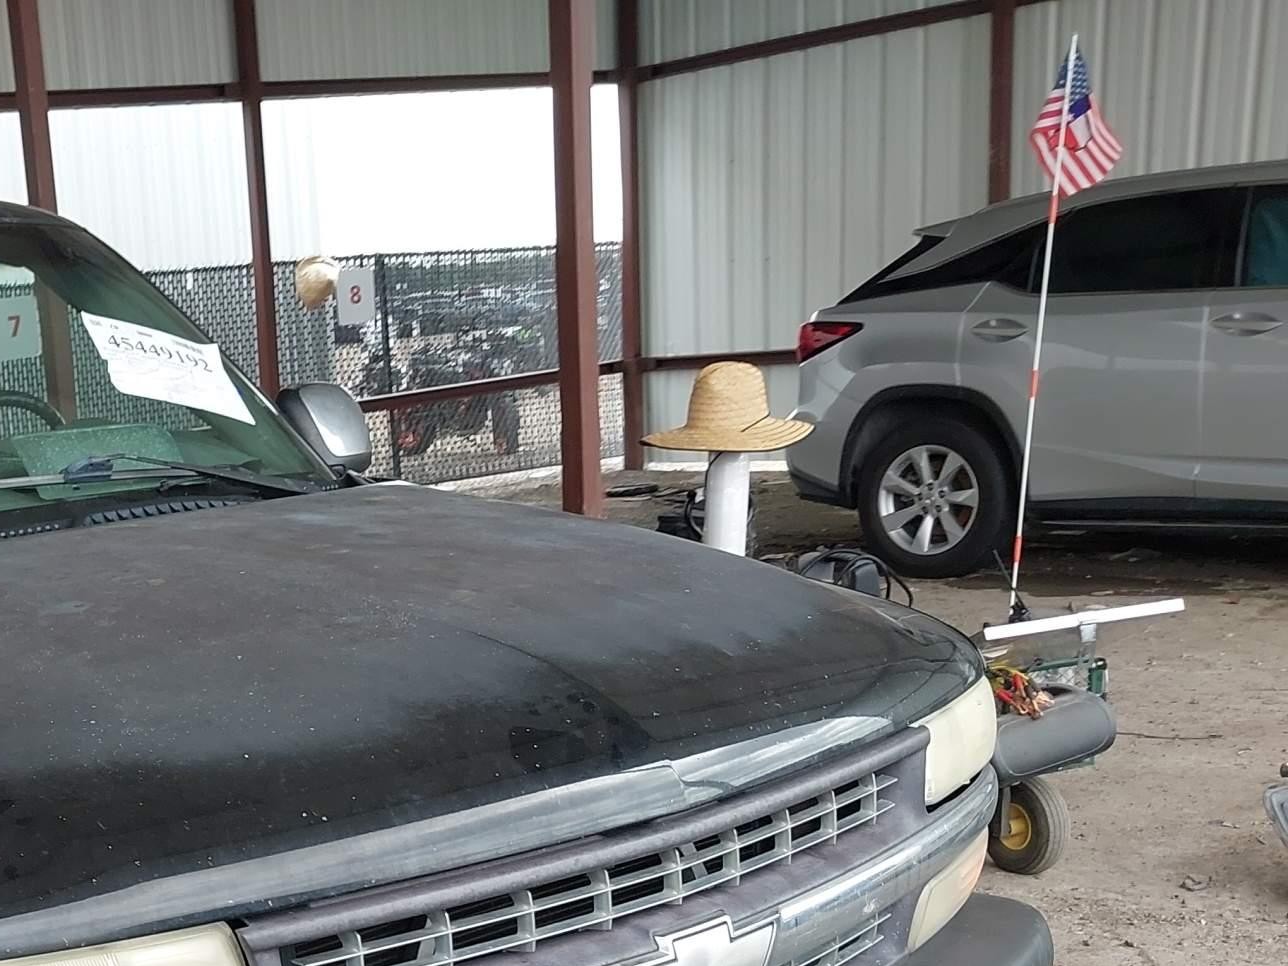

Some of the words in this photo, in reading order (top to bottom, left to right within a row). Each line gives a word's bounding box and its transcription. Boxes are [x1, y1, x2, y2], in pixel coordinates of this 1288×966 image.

[350, 284, 362, 304] 8
[7, 315, 21, 337] 7
[107, 334, 214, 373] 45449192
